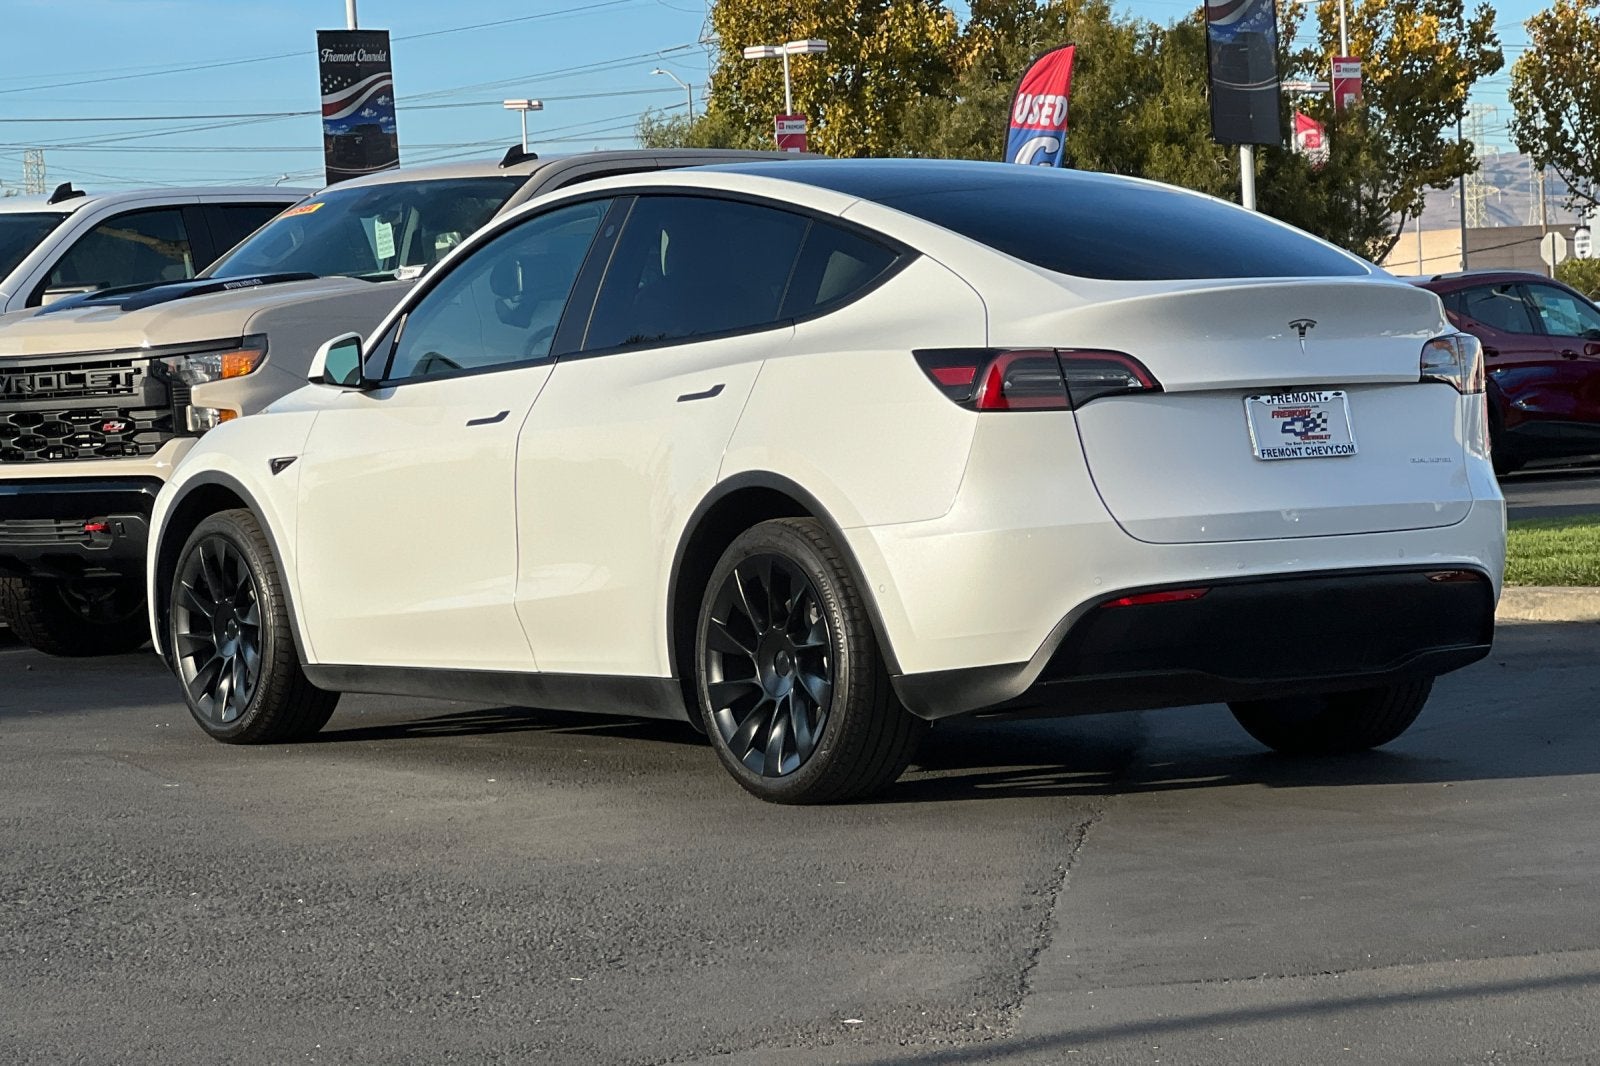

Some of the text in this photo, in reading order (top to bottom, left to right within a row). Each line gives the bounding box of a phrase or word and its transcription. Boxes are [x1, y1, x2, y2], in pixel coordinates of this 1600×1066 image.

[321, 48, 355, 63] Fremont
[1014, 93, 1068, 127] USED
[1271, 392, 1323, 404] FREMONT
[1261, 444, 1356, 459] FREMONT CHEVY.COM
